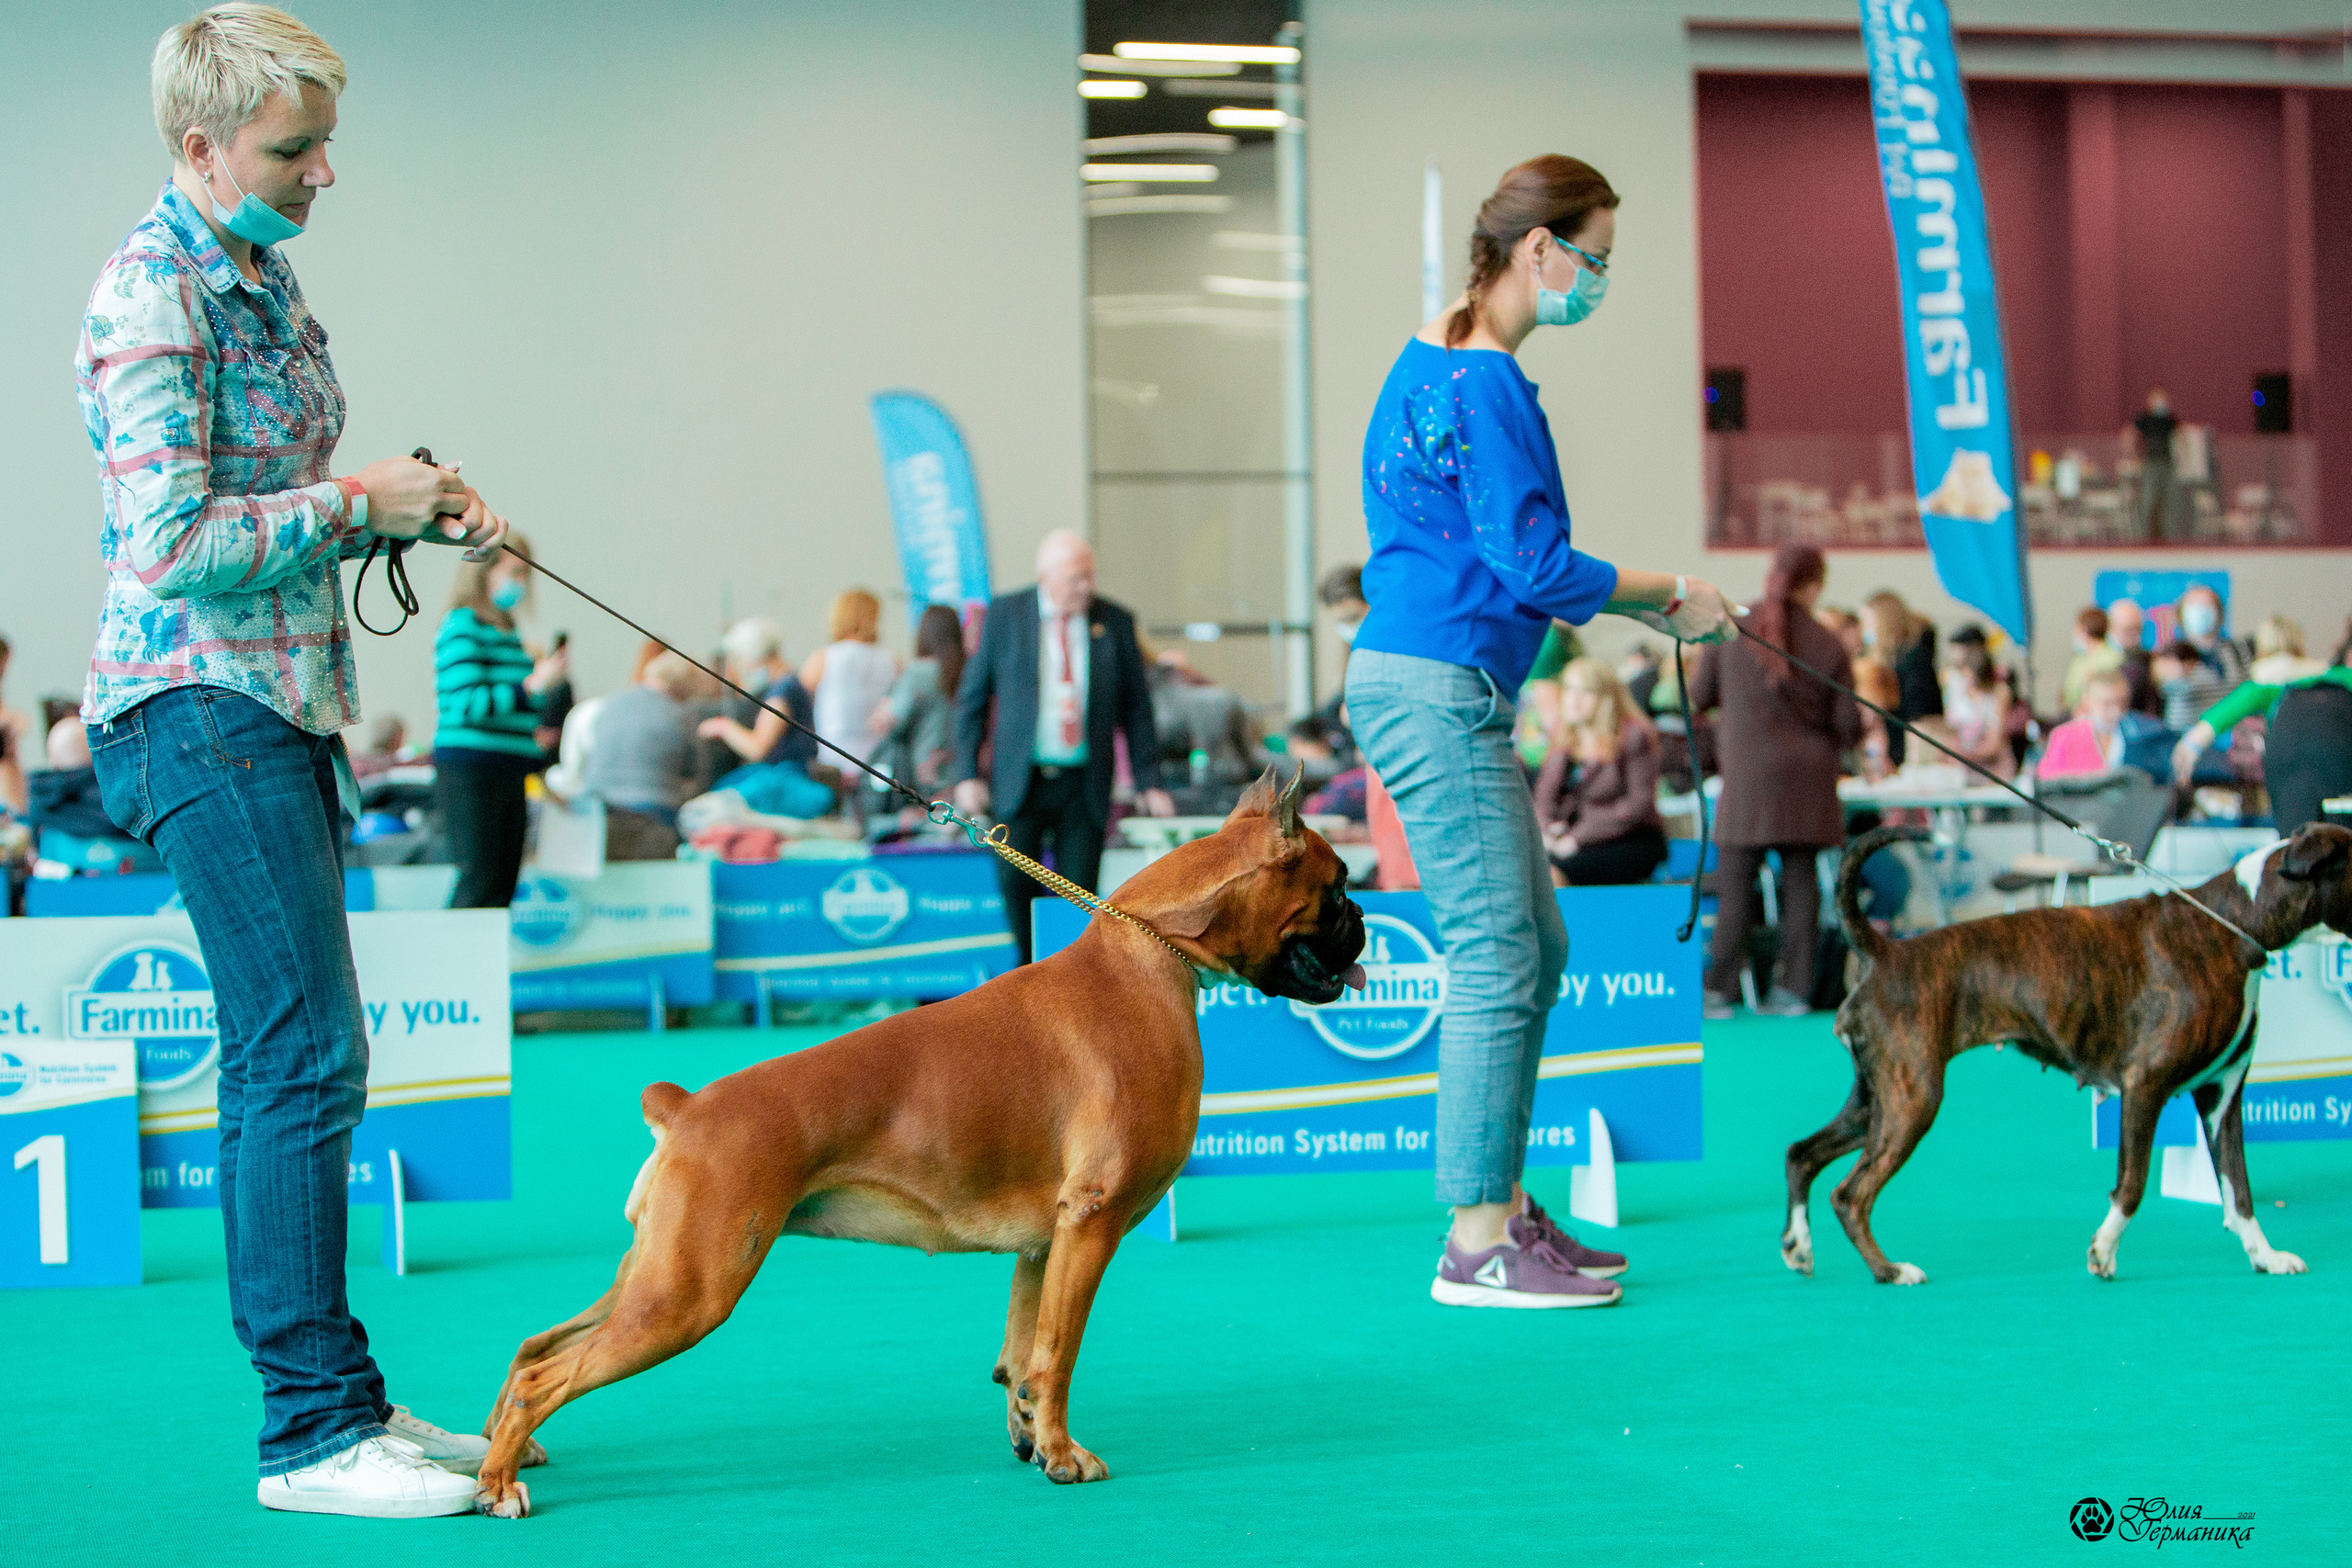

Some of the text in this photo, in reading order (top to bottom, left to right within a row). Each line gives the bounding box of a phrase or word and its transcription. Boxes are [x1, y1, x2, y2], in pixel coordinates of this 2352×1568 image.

[1601, 972, 1675, 1006] you.
[81, 998, 217, 1033] Farmina
[401, 999, 481, 1035] you.
[146, 1046, 192, 1062] Foods
[1295, 1128, 1385, 1159] System
[1396, 1125, 1430, 1151] for
[178, 1161, 215, 1187] for
[14, 1134, 70, 1264] 1
